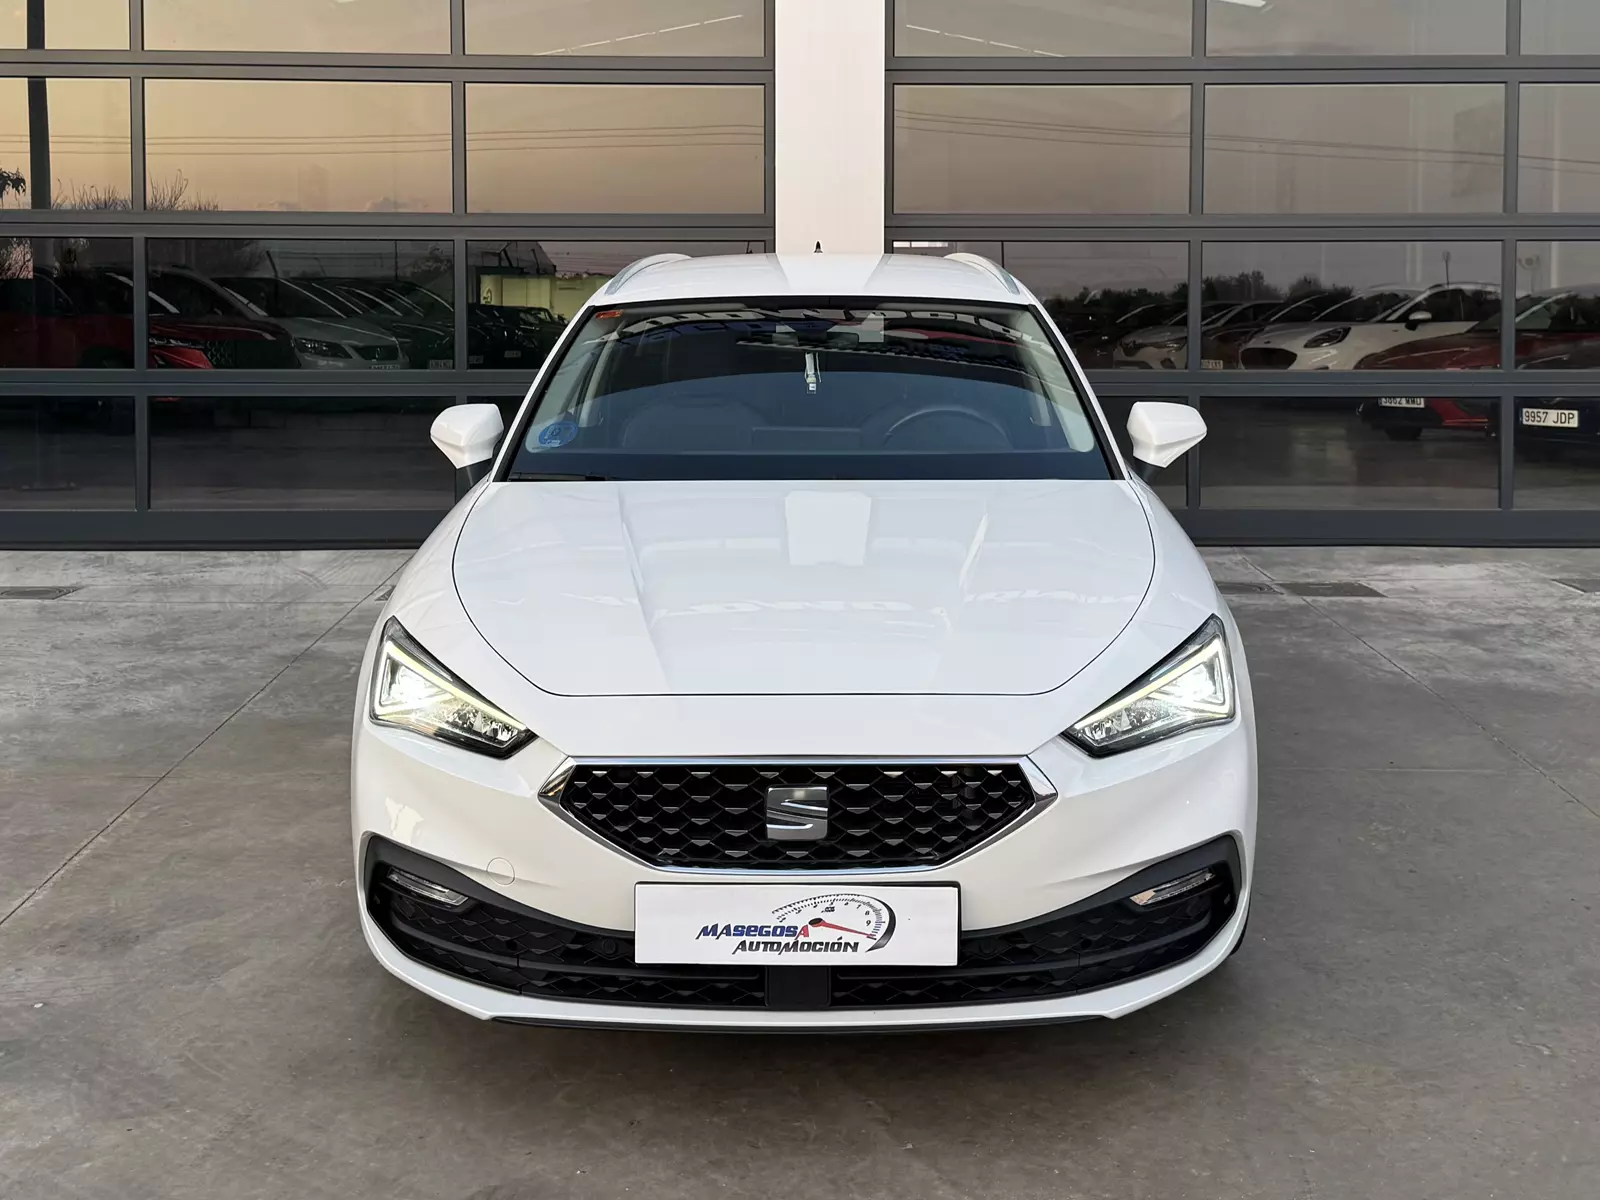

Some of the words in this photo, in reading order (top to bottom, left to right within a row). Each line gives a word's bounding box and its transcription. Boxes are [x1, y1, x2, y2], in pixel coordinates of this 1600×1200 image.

[1524, 410, 1549, 424] 9957
[1552, 411, 1575, 425] JDP
[732, 936, 859, 955] AUTOMOCIÓN
